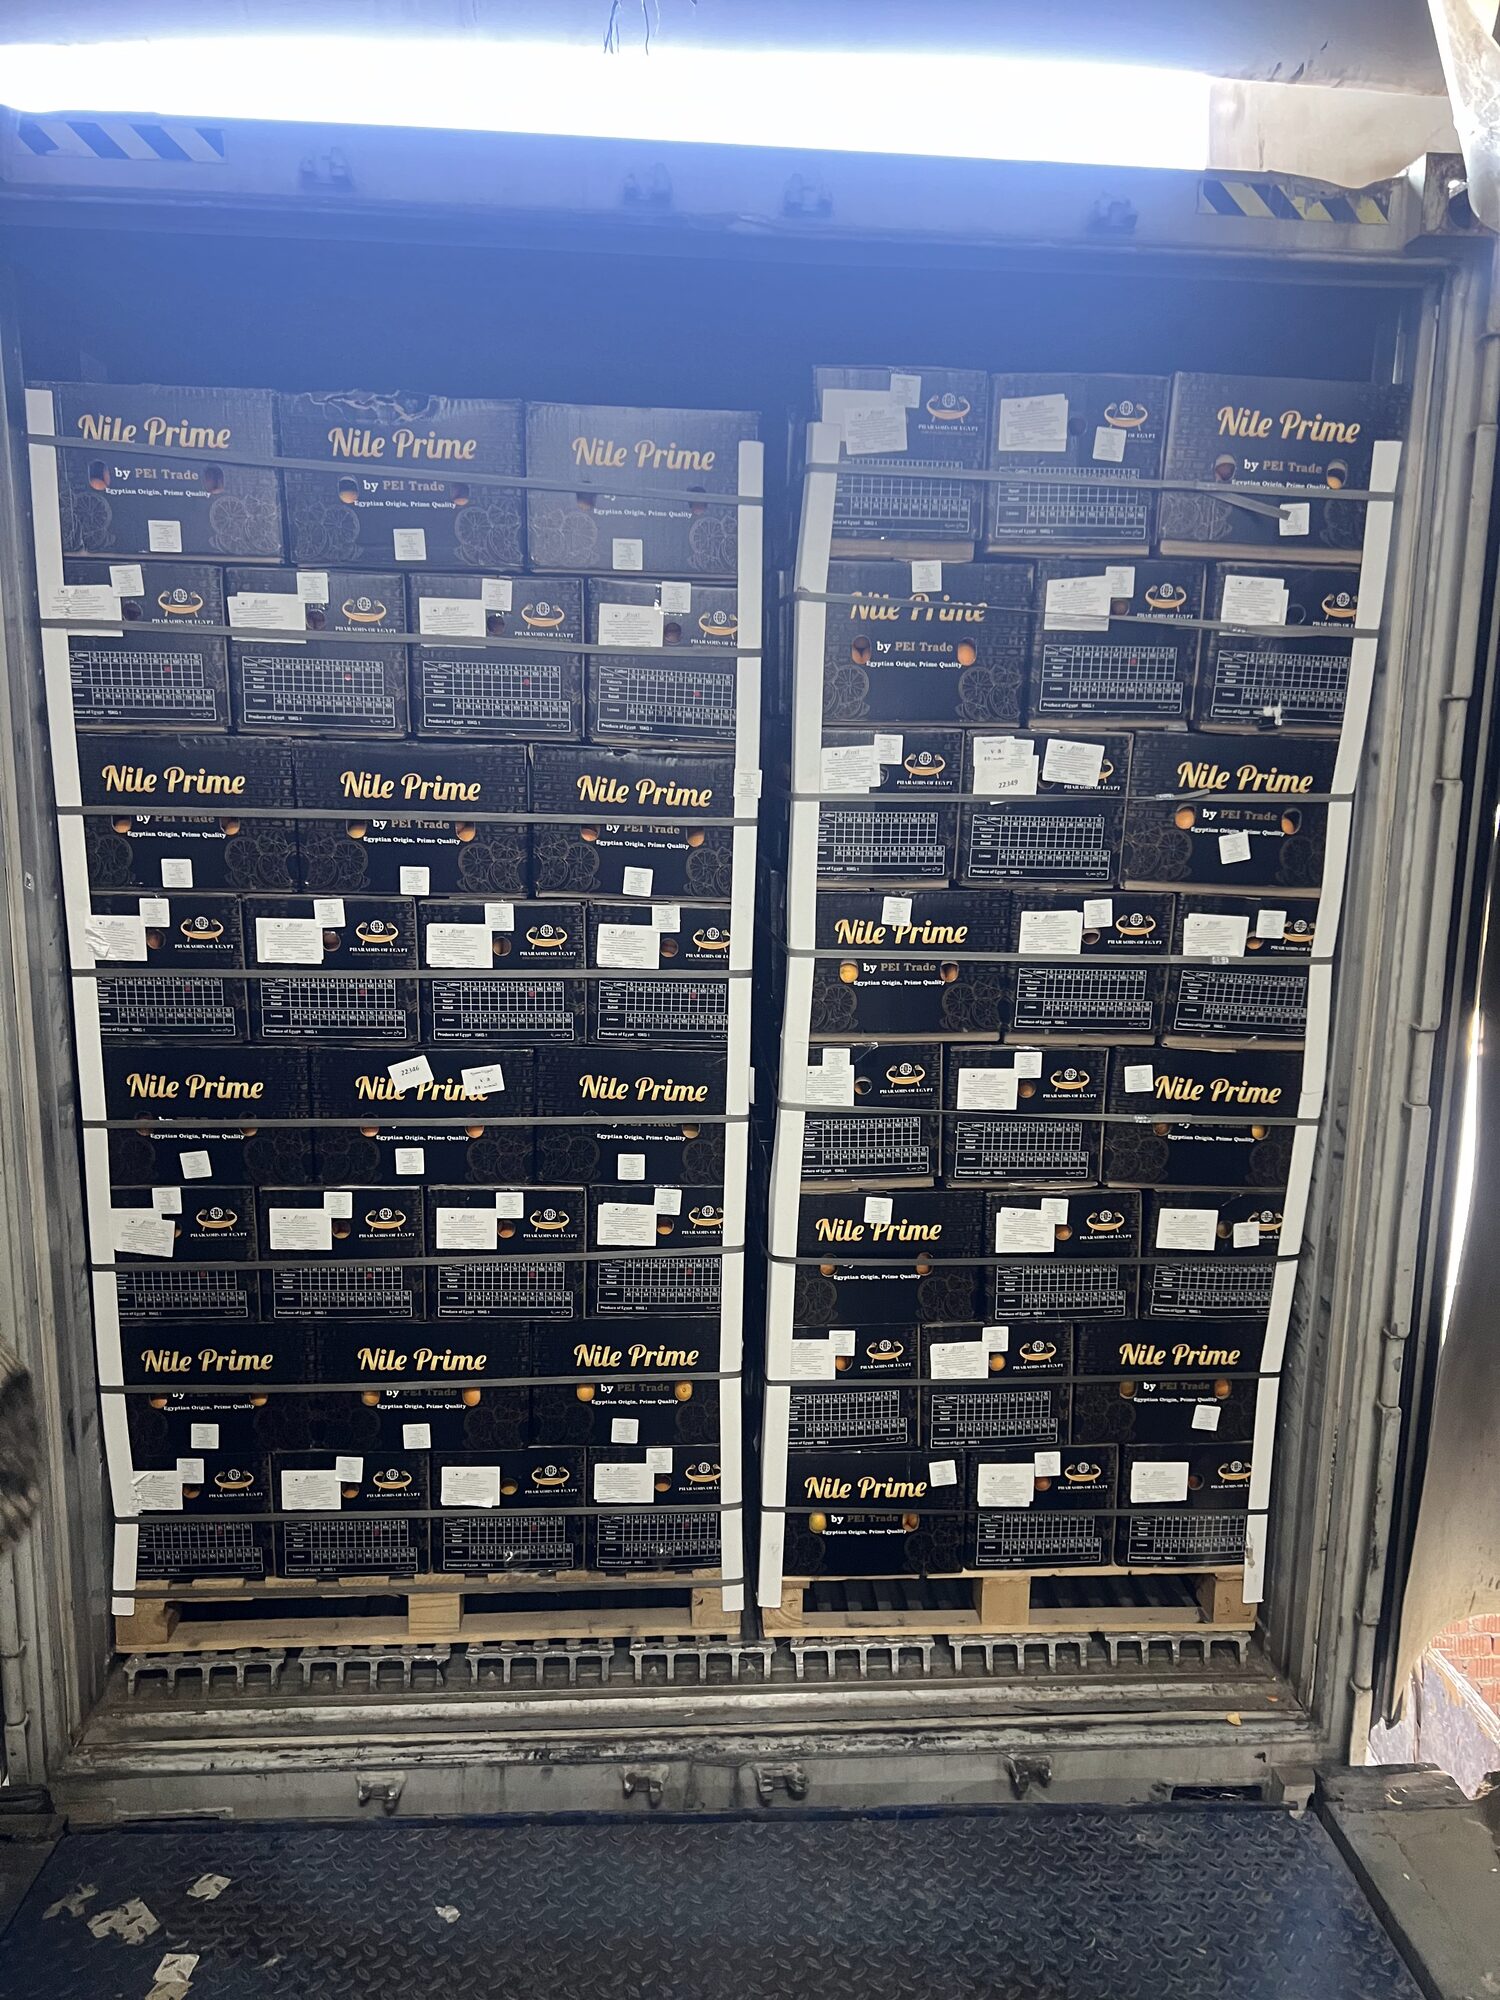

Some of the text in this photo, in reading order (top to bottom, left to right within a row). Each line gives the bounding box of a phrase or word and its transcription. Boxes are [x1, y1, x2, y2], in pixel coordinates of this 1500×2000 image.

[78, 414, 231, 448] Nile Prime
[1217, 406, 1361, 443] Nile Prime
[328, 427, 477, 459] Nile Prime
[572, 437, 715, 470] Nile Prime
[115, 467, 199, 480] by PEI Trade
[1244, 459, 1322, 473] by PEI Trade
[186, 490, 210, 498] Quality
[363, 480, 445, 492] by PEI Trade
[432, 501, 456, 509] Quality
[669, 511, 692, 519] Quality
[877, 641, 952, 653] by PEI Trade
[939, 661, 961, 669] Quality
[102, 765, 246, 794] Nile Prime
[340, 771, 480, 801] Nile Prime
[1177, 761, 1314, 793] Nile Prime
[577, 775, 712, 807] Nile Prime
[373, 820, 387, 829] by
[416, 820, 449, 829] Trade
[1203, 809, 1277, 820] by PEI Trade
[606, 824, 620, 833] by
[647, 826, 680, 834] Trade
[667, 842, 689, 850] Quality
[834, 919, 968, 944] Nile Prime
[863, 963, 936, 973] by PEI Trade
[126, 1073, 264, 1098] Nile Prime
[579, 1074, 708, 1102] Nile Prime
[1155, 1076, 1282, 1104] Nile Prime
[816, 1218, 942, 1241] Nile Prime
[141, 1349, 273, 1372] Nile Prime
[358, 1348, 486, 1371] Nile Prime
[574, 1344, 700, 1367] Nile Prime
[1119, 1343, 1240, 1366] Nile Prime
[386, 1390, 399, 1398] by
[600, 1384, 670, 1393] by PEI Trade
[1144, 1382, 1156, 1392] by
[804, 1476, 928, 1498] Nile Prime
[831, 1515, 844, 1524] by
